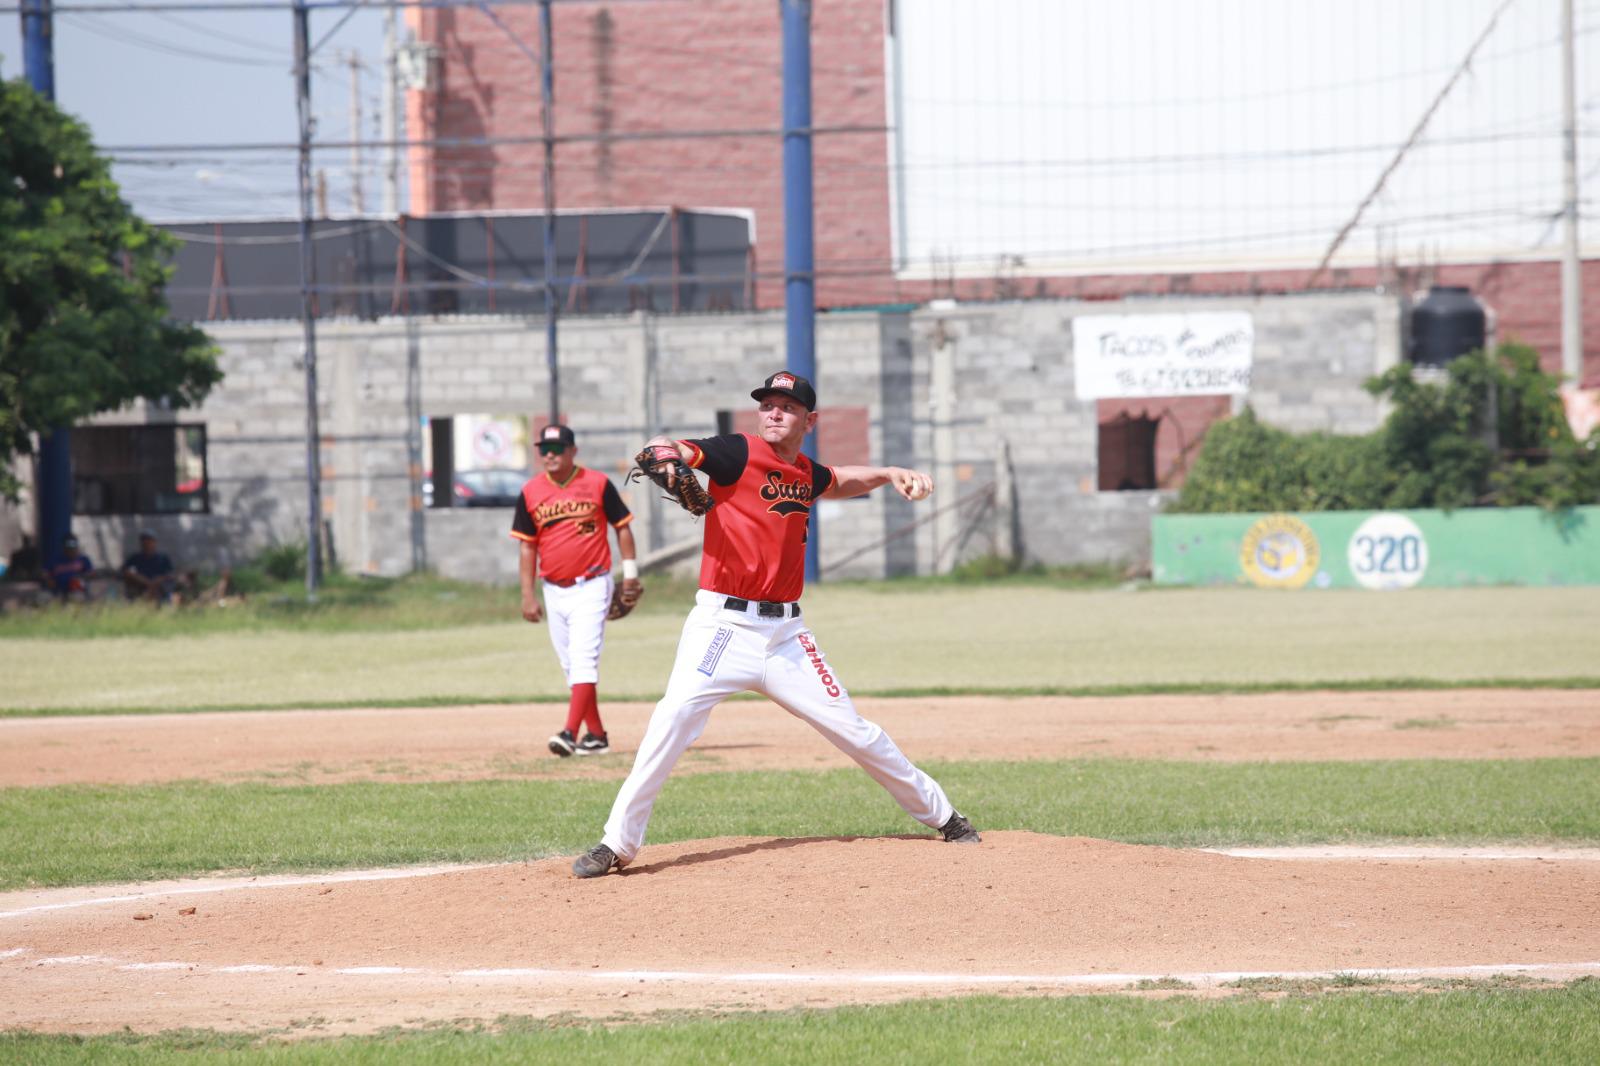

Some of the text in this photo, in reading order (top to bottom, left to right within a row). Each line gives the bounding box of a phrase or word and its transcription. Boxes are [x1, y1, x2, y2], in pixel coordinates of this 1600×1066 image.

[1098, 331, 1168, 357] TACOS
[760, 470, 813, 503] Suter
[534, 499, 595, 523] Suterm
[1356, 534, 1420, 574] 320
[798, 634, 840, 697] GONHER
